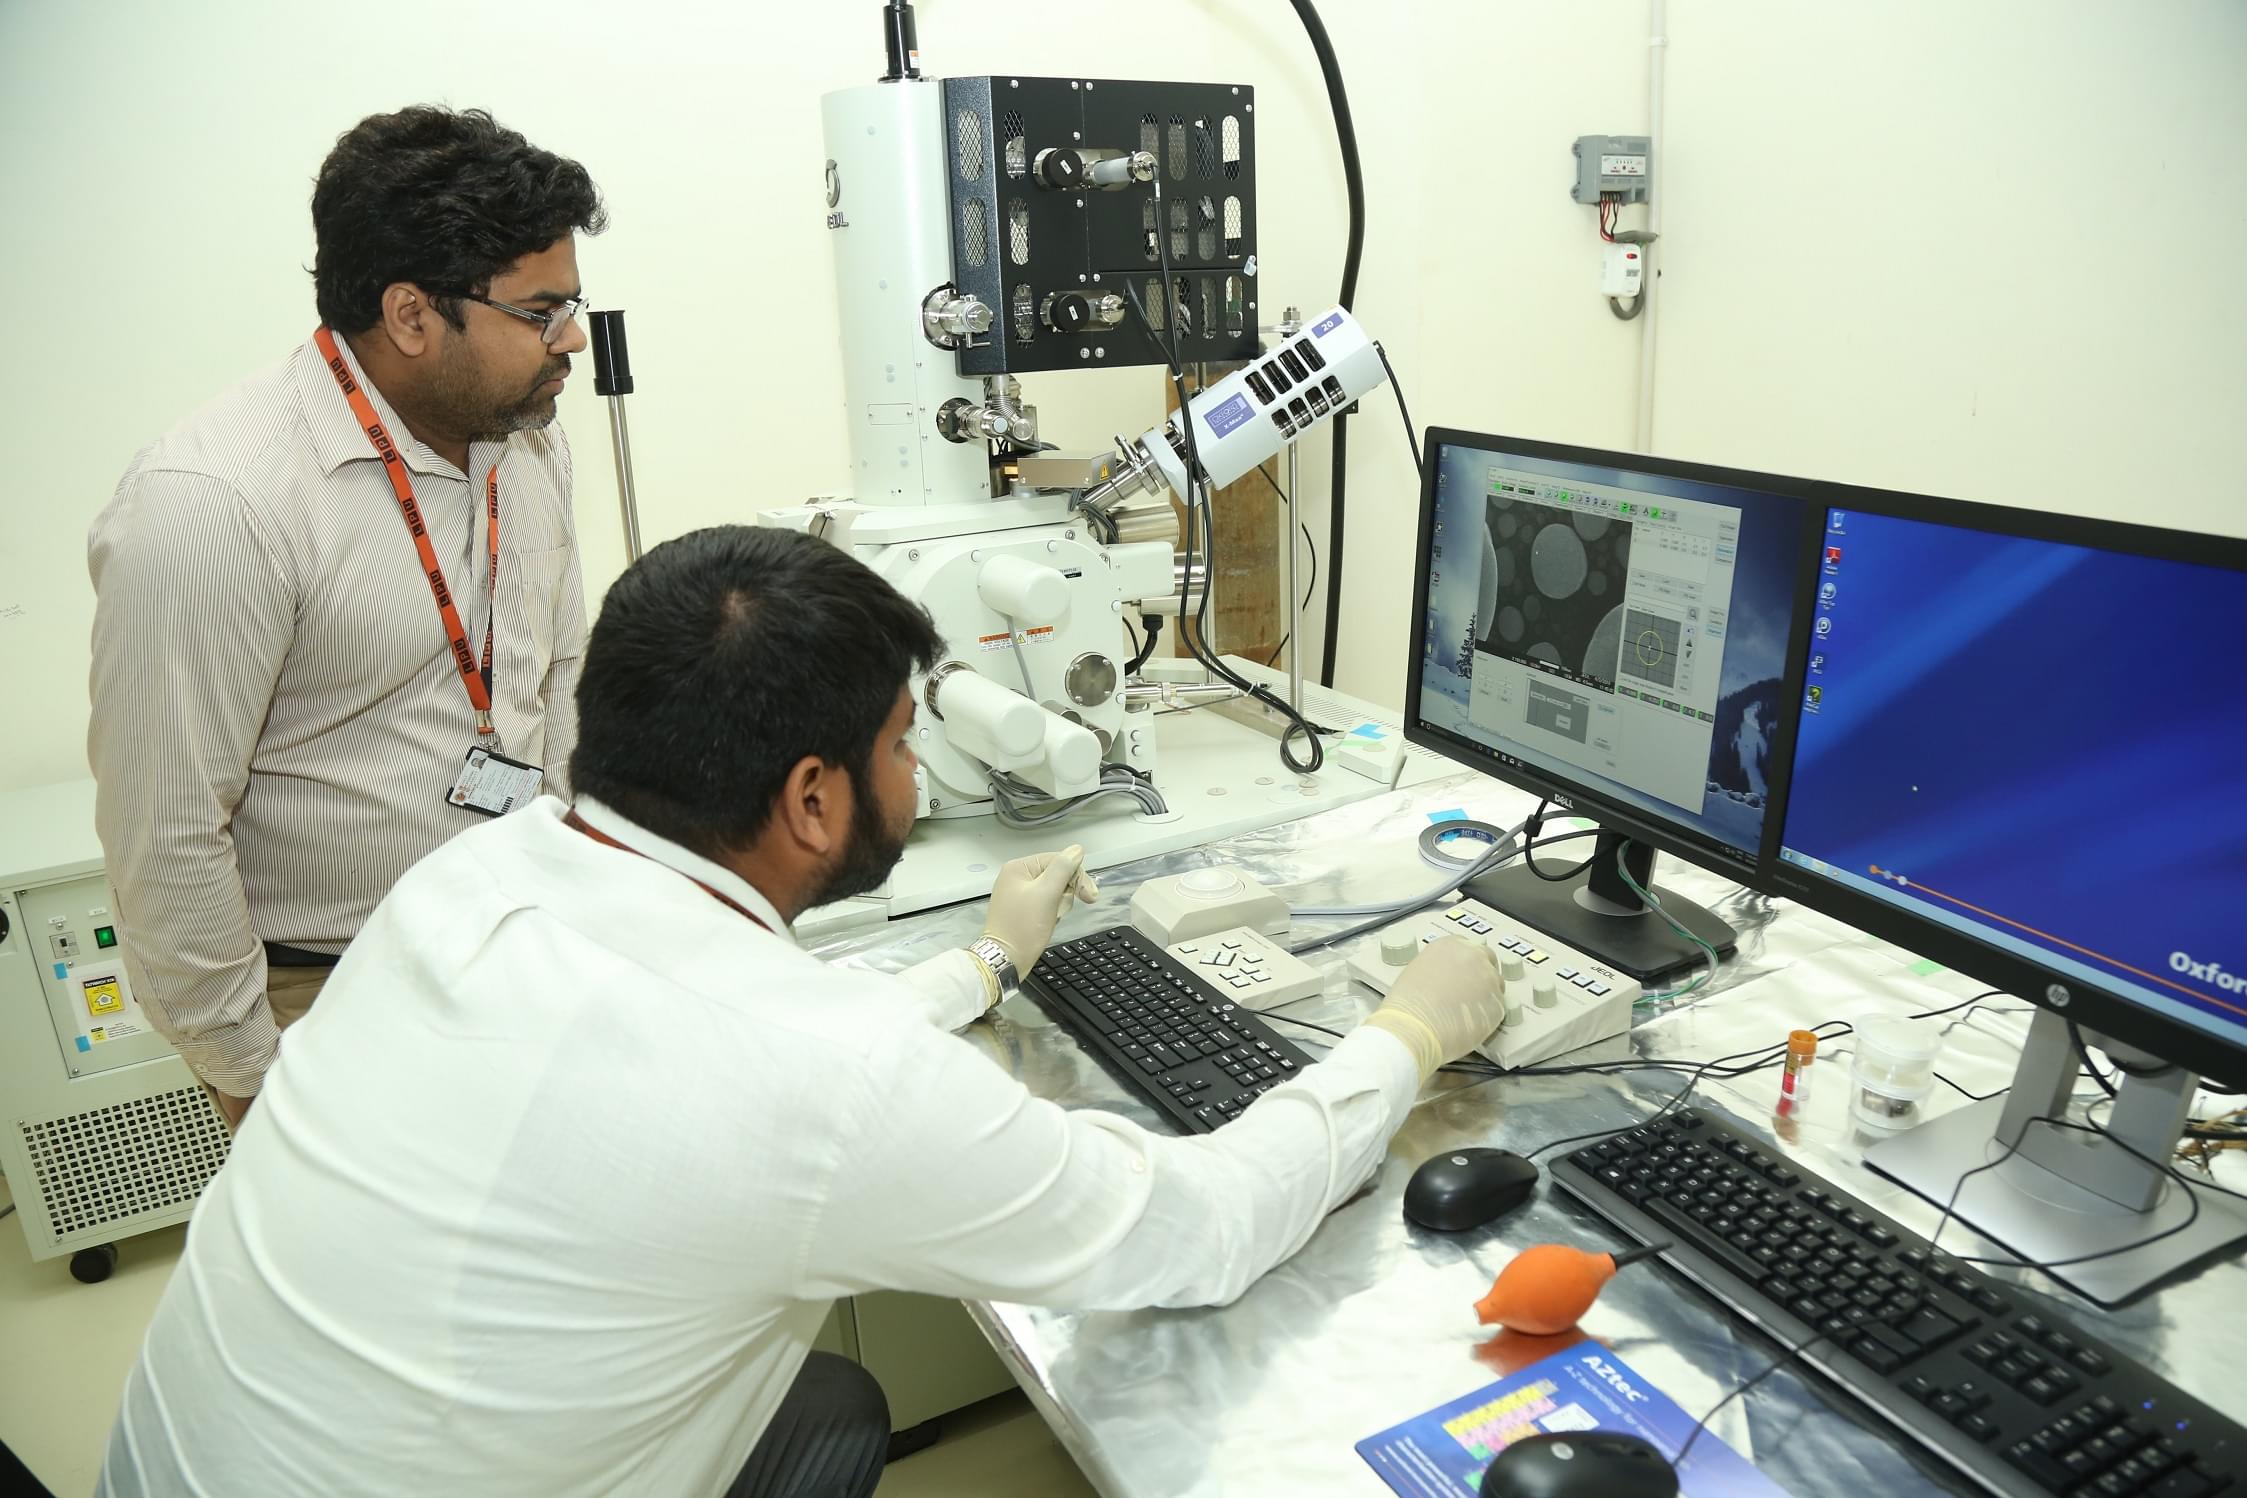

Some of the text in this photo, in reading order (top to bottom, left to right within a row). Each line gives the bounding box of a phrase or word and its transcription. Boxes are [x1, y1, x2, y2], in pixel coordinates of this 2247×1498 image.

[1321, 320, 1334, 332] 20
[1554, 793, 1574, 809] DELL
[1590, 966, 1615, 980] JEOL
[2168, 951, 2247, 995] Oxfor
